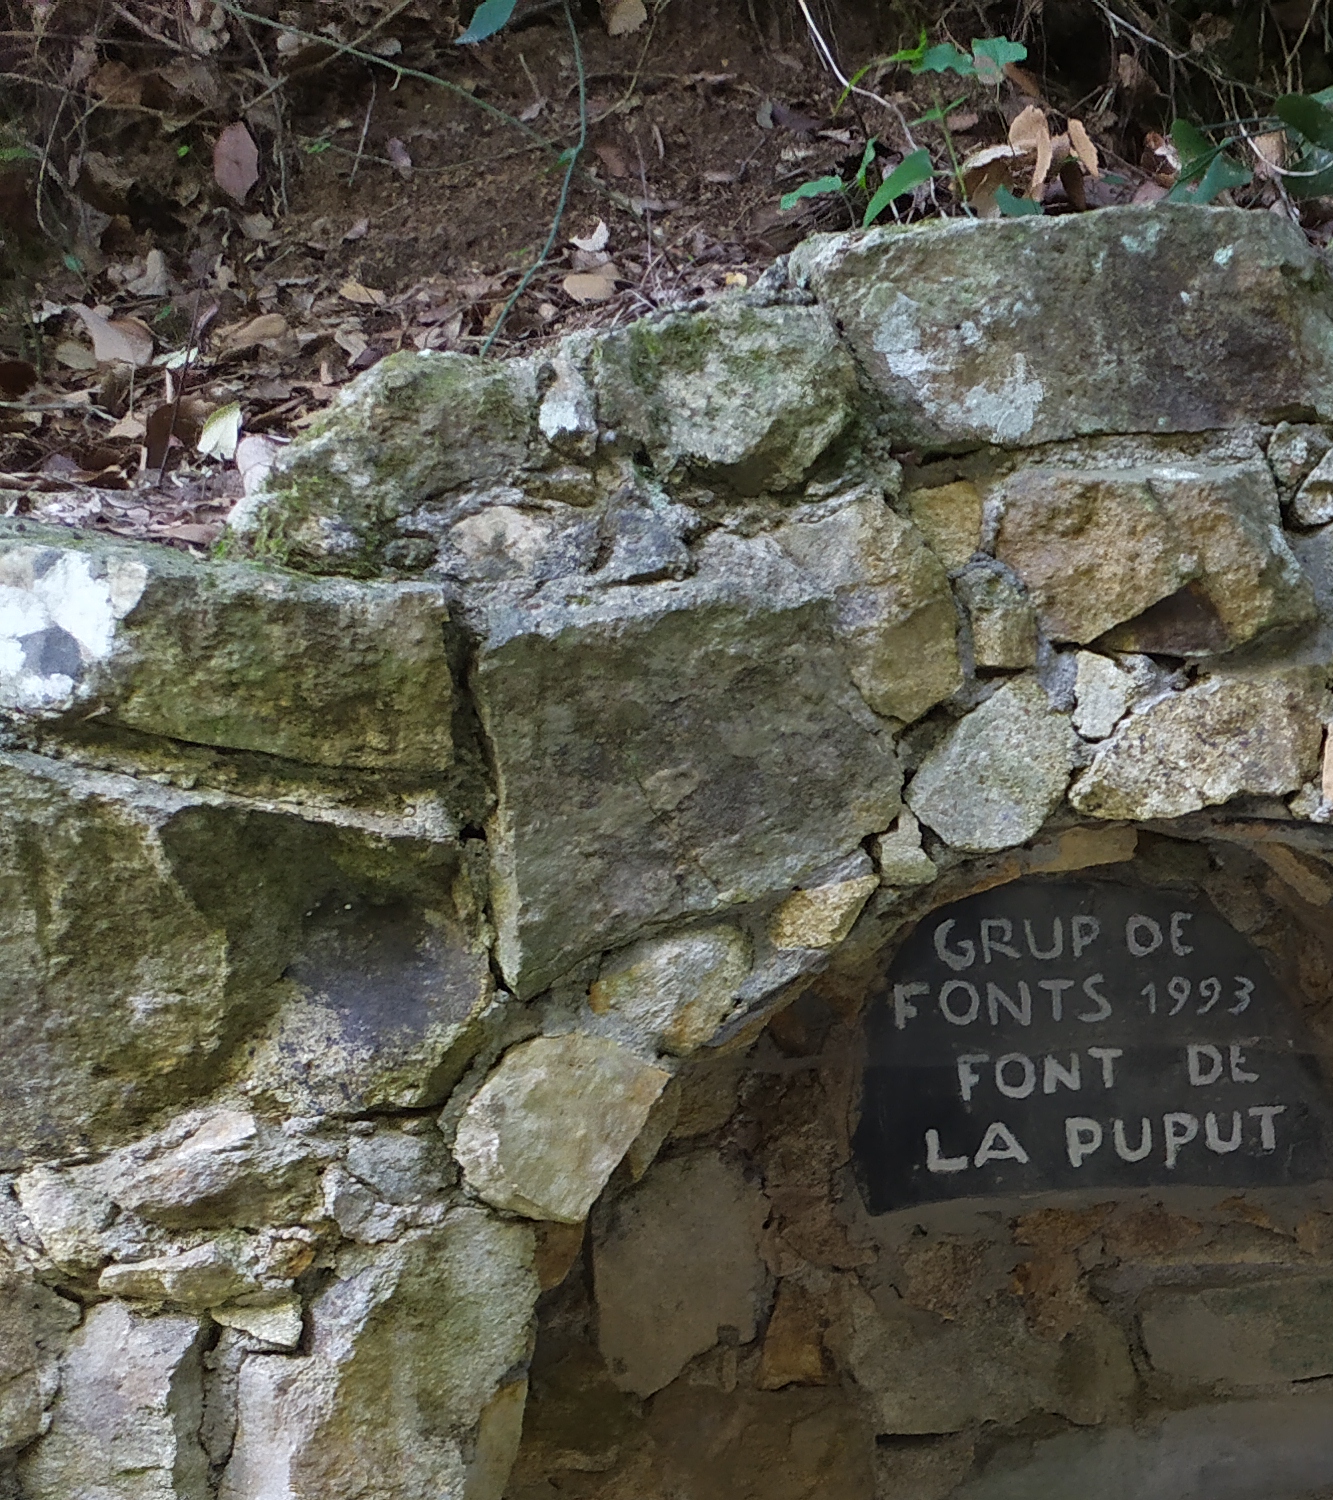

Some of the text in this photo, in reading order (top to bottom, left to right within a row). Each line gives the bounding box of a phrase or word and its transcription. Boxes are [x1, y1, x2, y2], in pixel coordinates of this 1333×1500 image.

[934, 911, 1195, 972] GRUP DE
[893, 973, 1257, 1030] FONTS 1993
[957, 1043, 1260, 1102] FONT DE
[924, 1105, 1288, 1174] LA PUPUT
